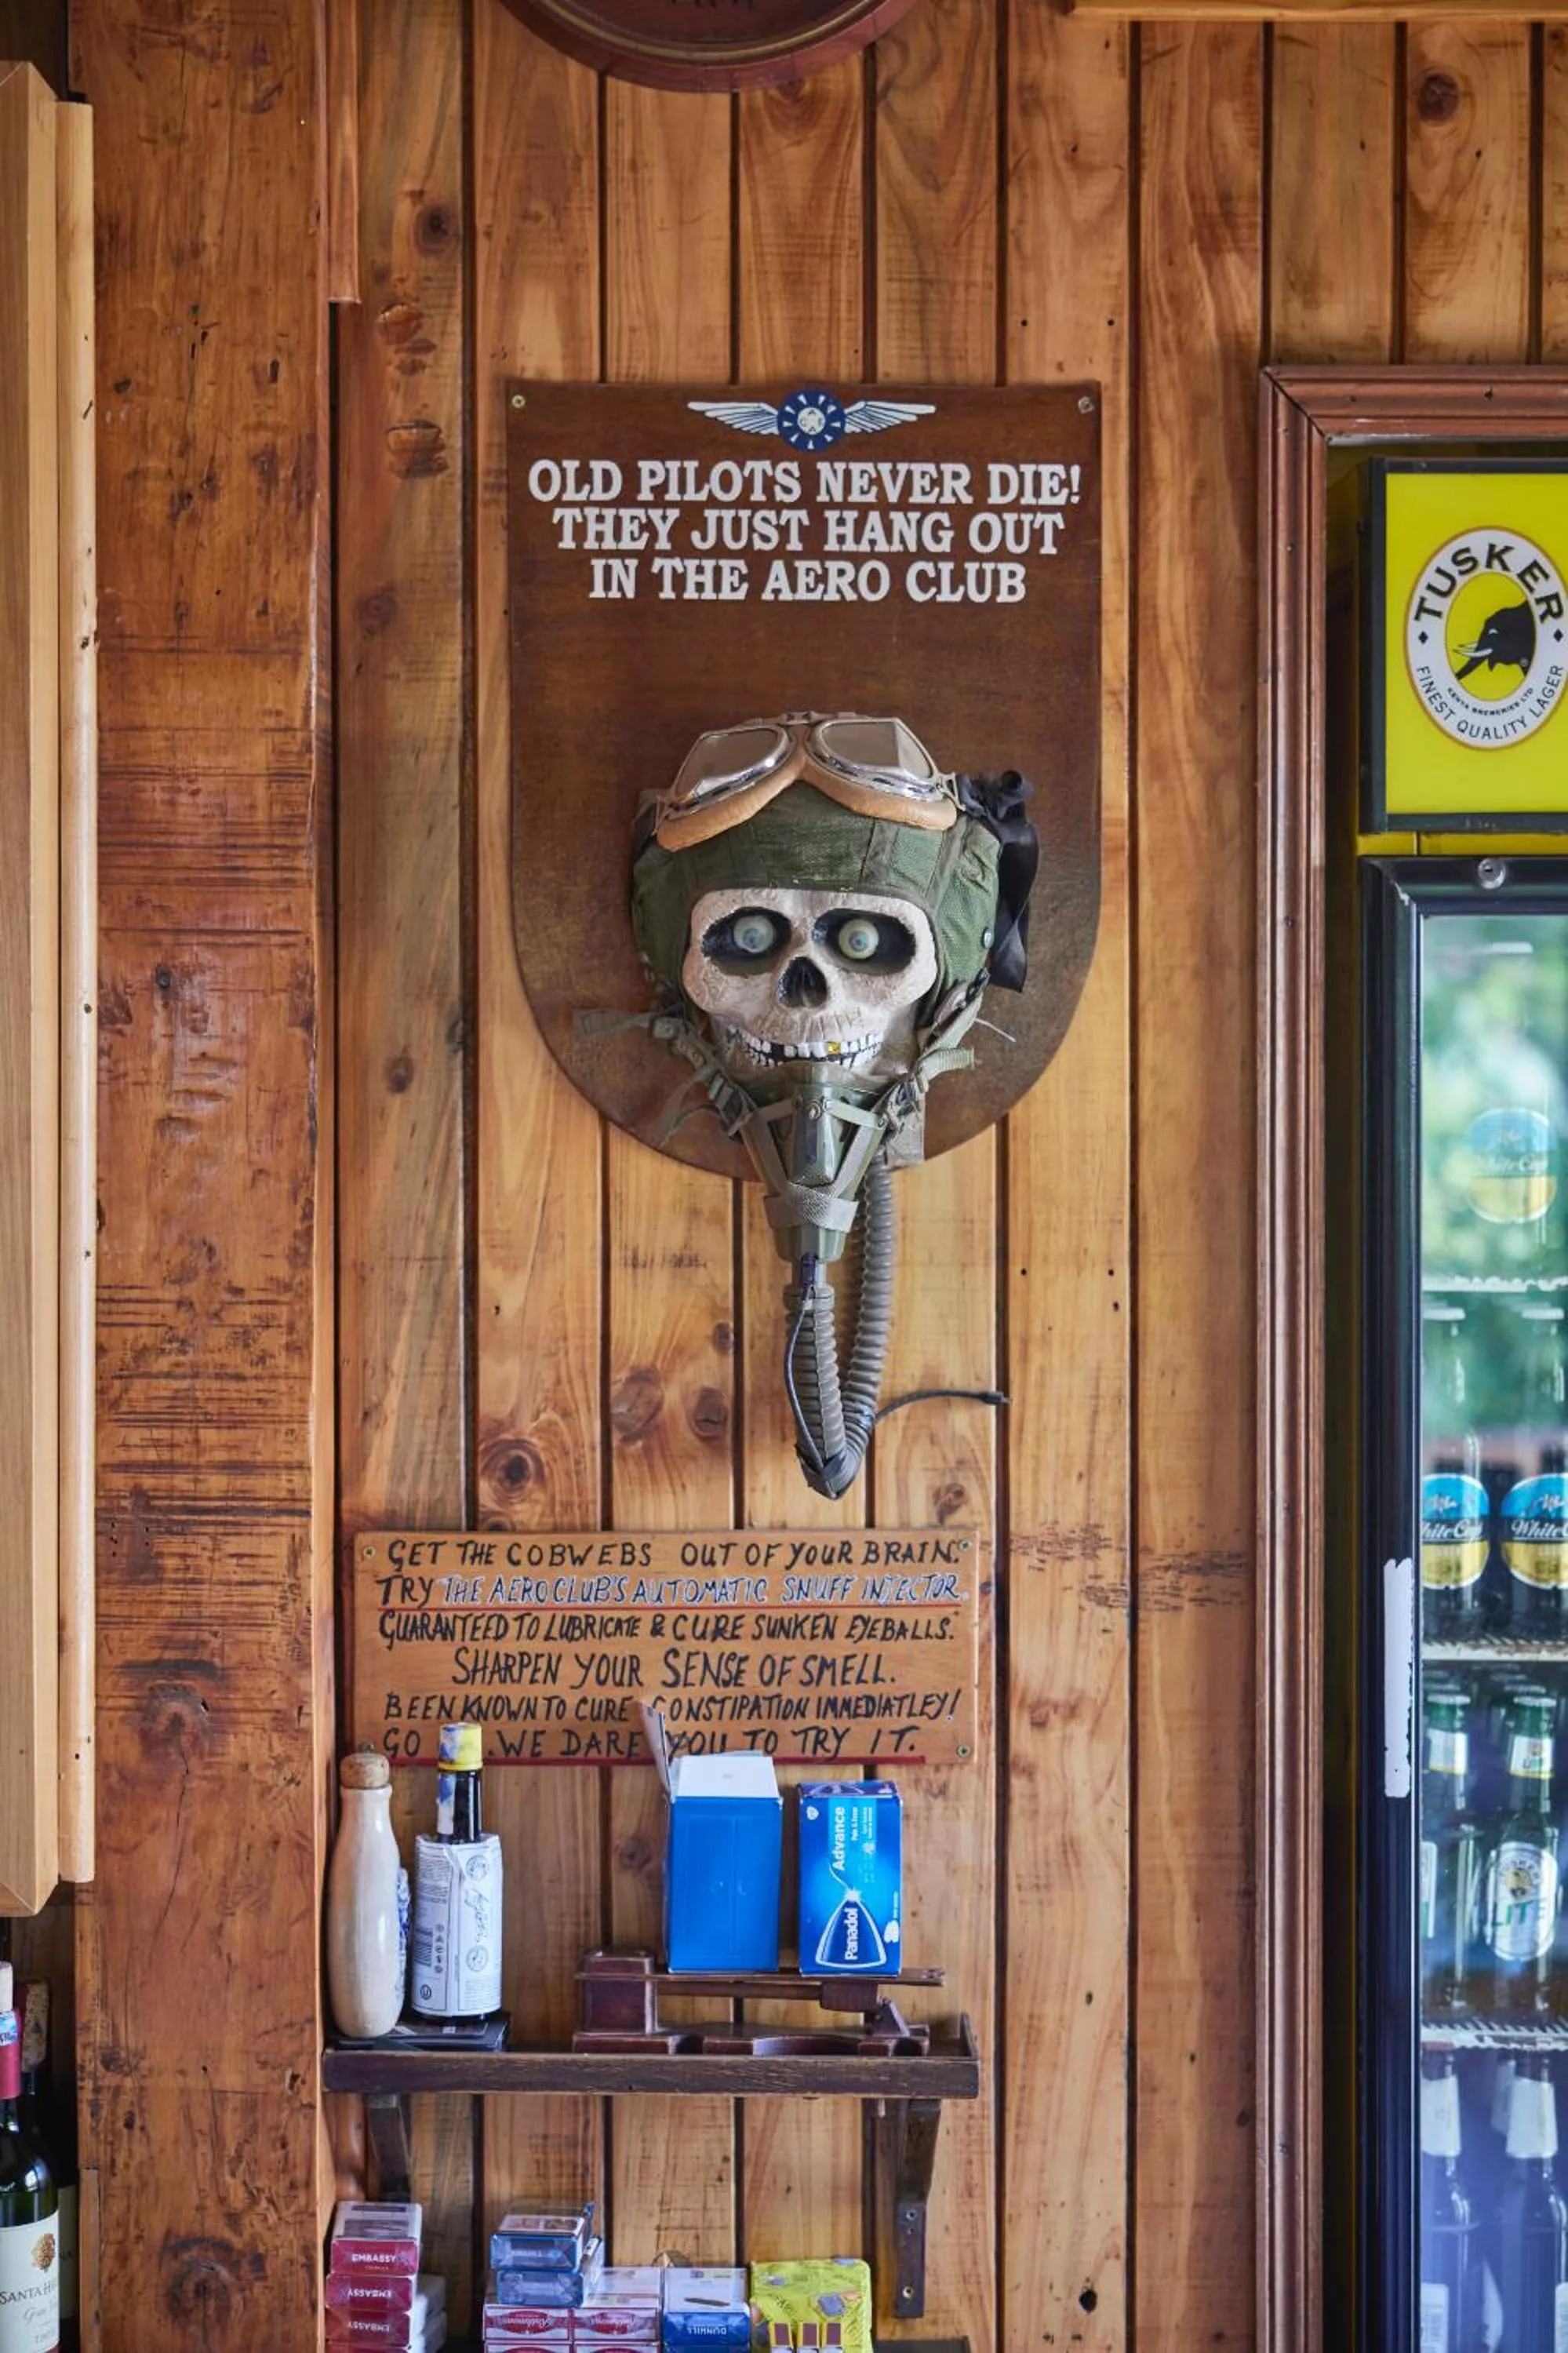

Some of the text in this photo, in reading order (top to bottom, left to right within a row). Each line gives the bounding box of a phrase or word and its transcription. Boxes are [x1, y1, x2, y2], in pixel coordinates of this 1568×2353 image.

[529, 459, 1081, 506] OLD PILOTS NEVER DIE!
[552, 507, 1065, 555] THEY JUST HANG OUT
[589, 557, 1026, 603] IN THE AERO CLUB
[1414, 543, 1564, 625] TUSKER
[1417, 665, 1564, 740] FINEST QUALITY LAGER
[1512, 1519, 1560, 1538] White
[388, 1539, 960, 1572] GET THE COBWEBS OUT OF YOUR BRAIN.
[375, 1573, 435, 1608] TRY
[439, 1574, 485, 1604] THE
[488, 1575, 549, 1604] AERO
[631, 1576, 769, 1604] AUTOMATIC
[781, 1573, 857, 1602] SNUFF
[378, 1609, 955, 1650] GUARANTEED TO LUBRICATE & CURE SUNKEN EYEBALLS.
[451, 1646, 896, 1690] SHARPEN YOUR SENSE OF SMELL.
[384, 1694, 456, 1721] BEEN
[460, 1695, 540, 1723] KNOWN
[540, 1695, 566, 1721] TO
[573, 1696, 631, 1722] CURE
[816, 1688, 962, 1721] IMMEDIATLEY!
[384, 1727, 421, 1759] GO
[496, 1728, 547, 1757] WE
[560, 1728, 644, 1757] DARE
[665, 1730, 728, 1763] YOU
[742, 1728, 780, 1754] TO
[790, 1725, 850, 1759] TRY
[831, 1807, 846, 1871] Advance
[844, 1907, 859, 1960] Panadol
[351, 2253, 397, 2264] EMBASSY
[347, 2287, 393, 2298] EMBASSY
[347, 2321, 391, 2332] EMBASSY
[686, 2326, 727, 2336] DUNHILL
